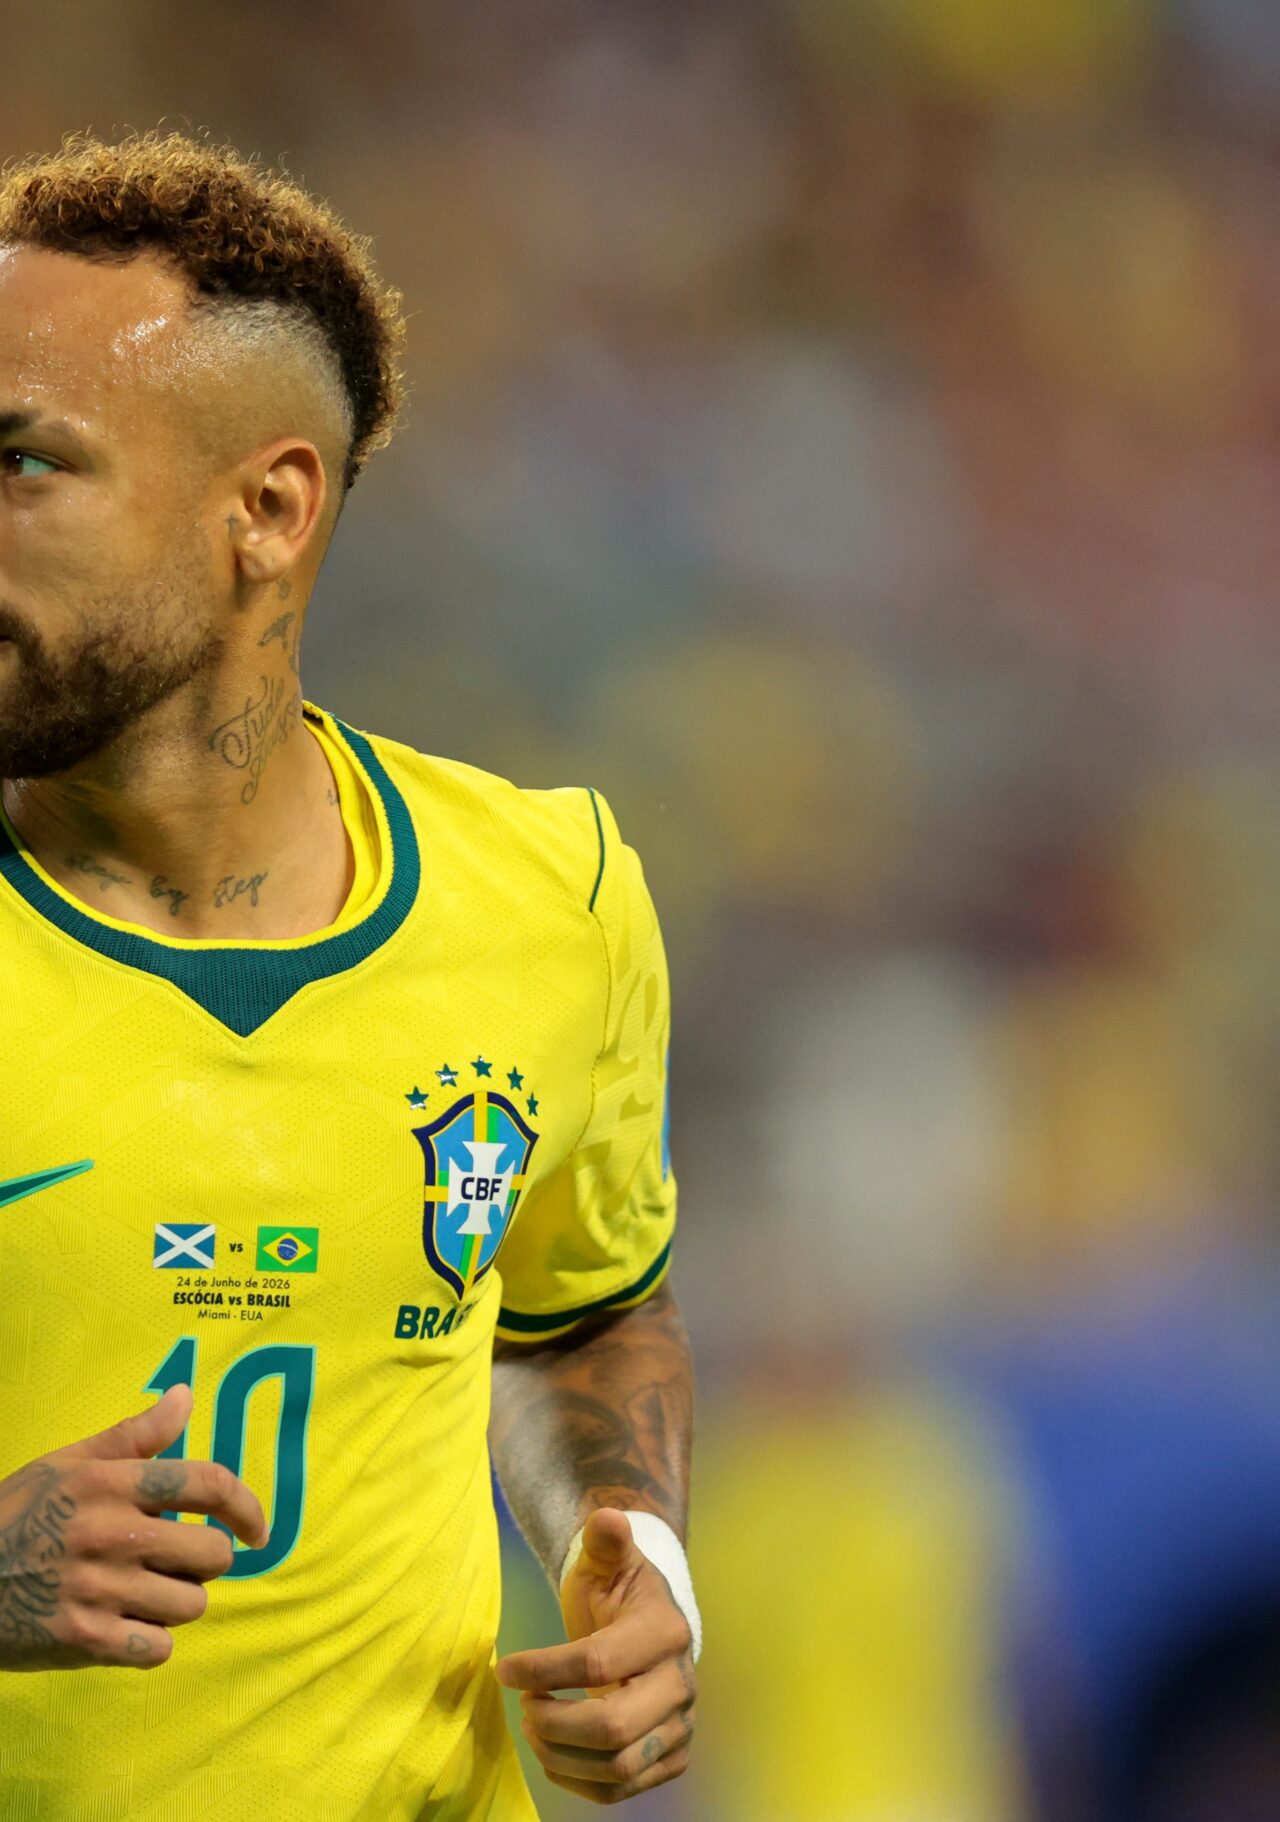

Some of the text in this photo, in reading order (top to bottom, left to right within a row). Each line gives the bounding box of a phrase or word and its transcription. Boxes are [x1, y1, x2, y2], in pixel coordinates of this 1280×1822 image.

[460, 1176, 503, 1202] CBF
[229, 1242, 244, 1253] vs
[177, 1276, 291, 1290] 24 de Junho de 2026
[173, 1289, 291, 1308] ESCÓCIA vs BRASIL
[197, 1309, 231, 1320] Miami
[240, 1310, 264, 1321] EUA
[394, 1303, 473, 1340] BRA
